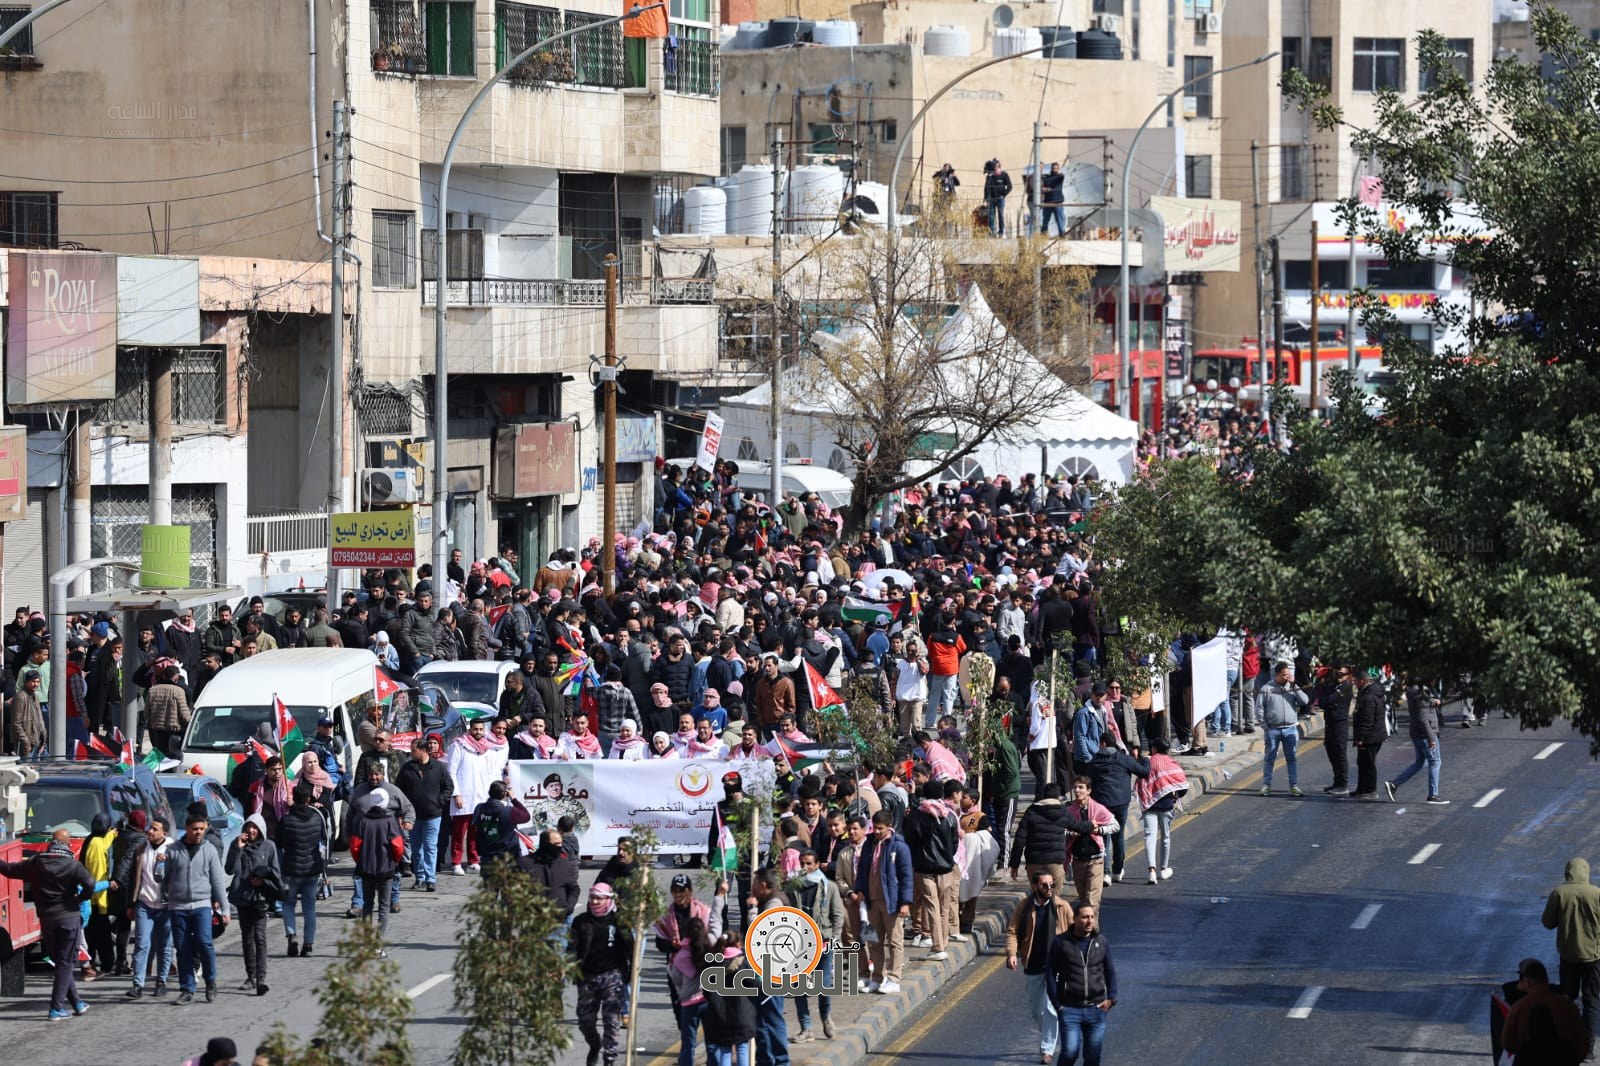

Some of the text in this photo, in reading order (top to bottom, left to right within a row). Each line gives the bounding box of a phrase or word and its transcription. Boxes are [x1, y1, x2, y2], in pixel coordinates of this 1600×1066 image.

[42, 268, 99, 336] ROYAL
[43, 345, 97, 378] SALOON
[335, 518, 411, 543] أرض تجاري للبيع
[333, 551, 376, 563] 0795042344
[627, 801, 684, 816] التخصصي
